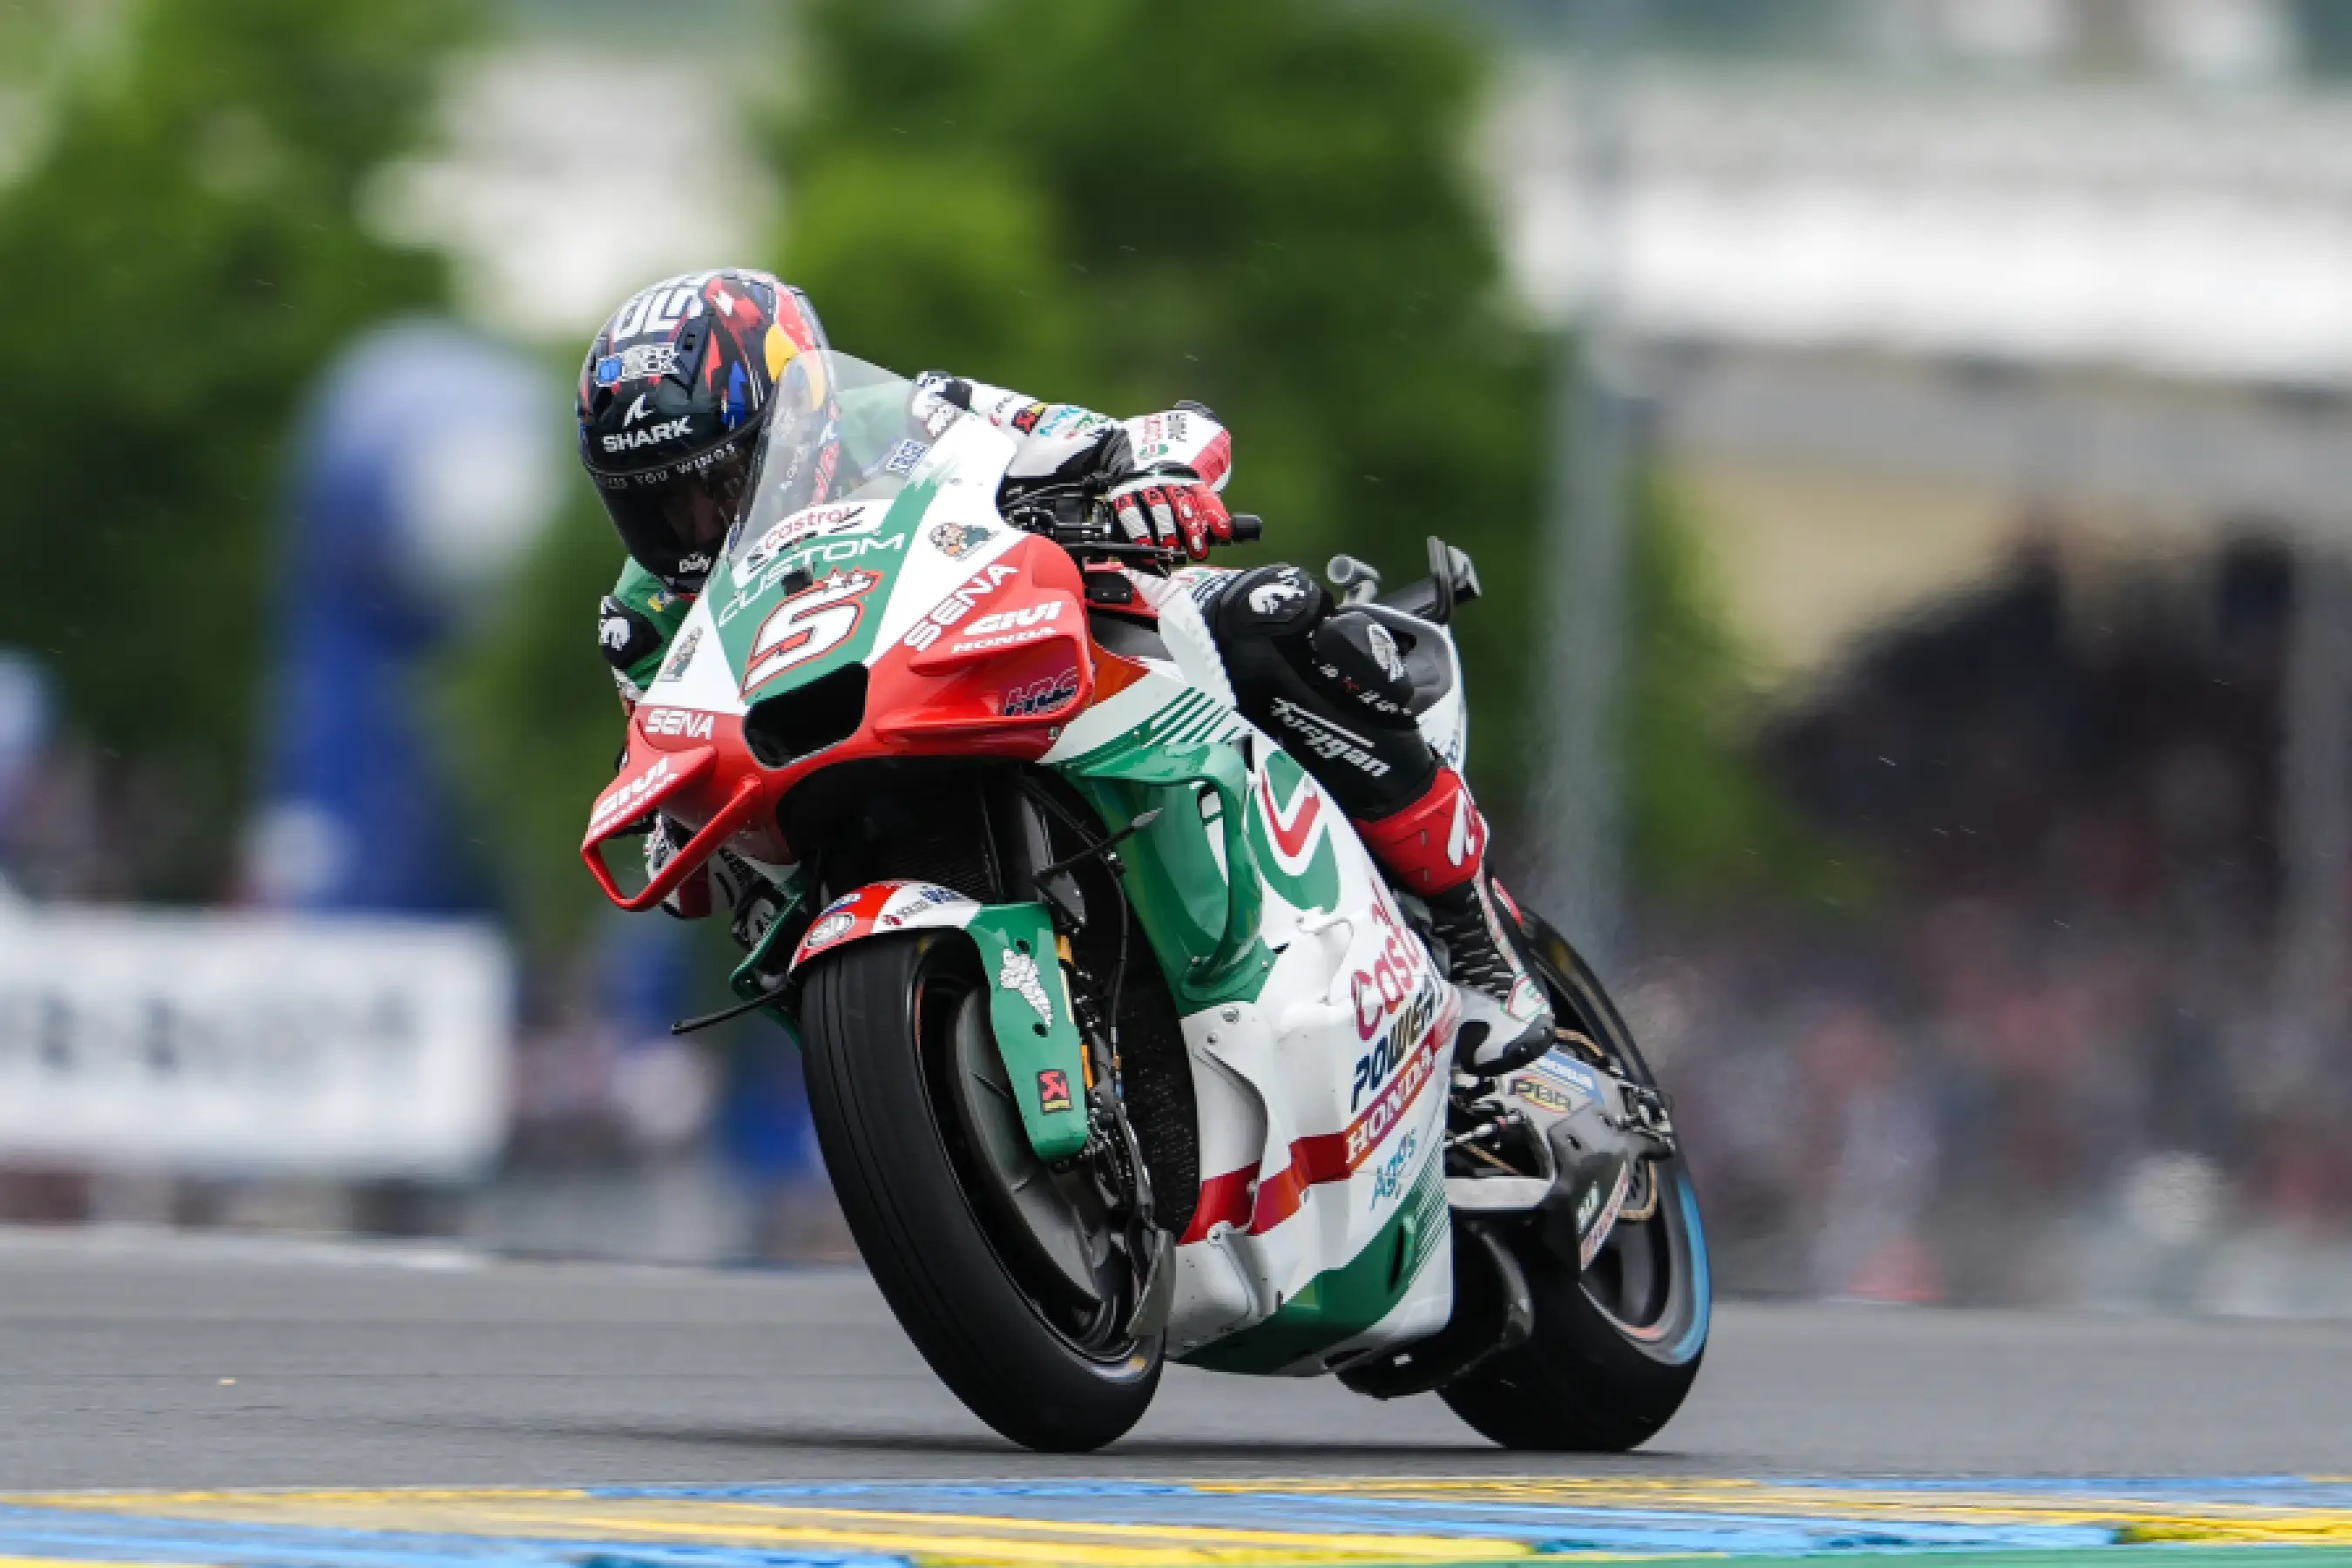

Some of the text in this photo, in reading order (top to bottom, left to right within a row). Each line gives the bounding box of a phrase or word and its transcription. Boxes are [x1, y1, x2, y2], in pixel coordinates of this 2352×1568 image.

[603, 416, 693, 452] SHARK
[740, 568, 884, 699] 5
[903, 564, 1018, 652] SENA
[963, 601, 1063, 636] GIVI
[645, 708, 714, 740] SENA
[1346, 1044, 1435, 1164] HONDA
